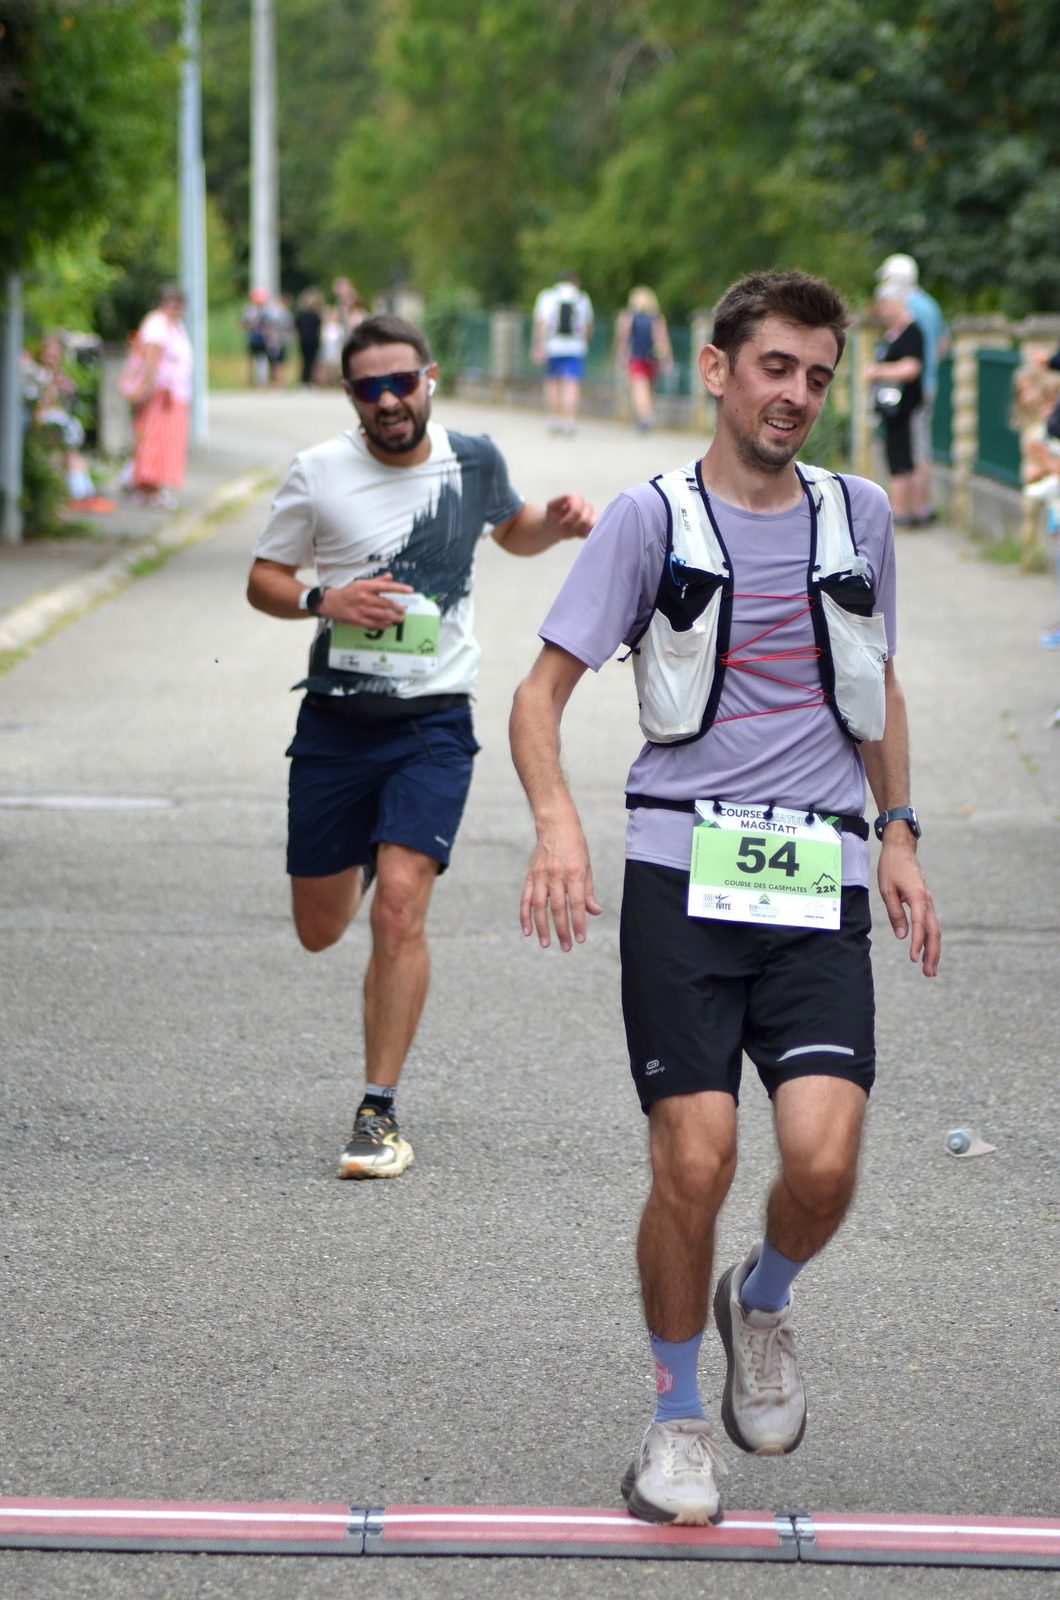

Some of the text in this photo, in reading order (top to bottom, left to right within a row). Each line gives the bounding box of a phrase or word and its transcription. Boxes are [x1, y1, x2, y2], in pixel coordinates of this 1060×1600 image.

[740, 820, 797, 835] MAGSTATT
[736, 836, 800, 877] 54
[724, 879, 751, 888] COURSE
[768, 883, 808, 893] CASEMATES
[815, 884, 837, 894] 22K
